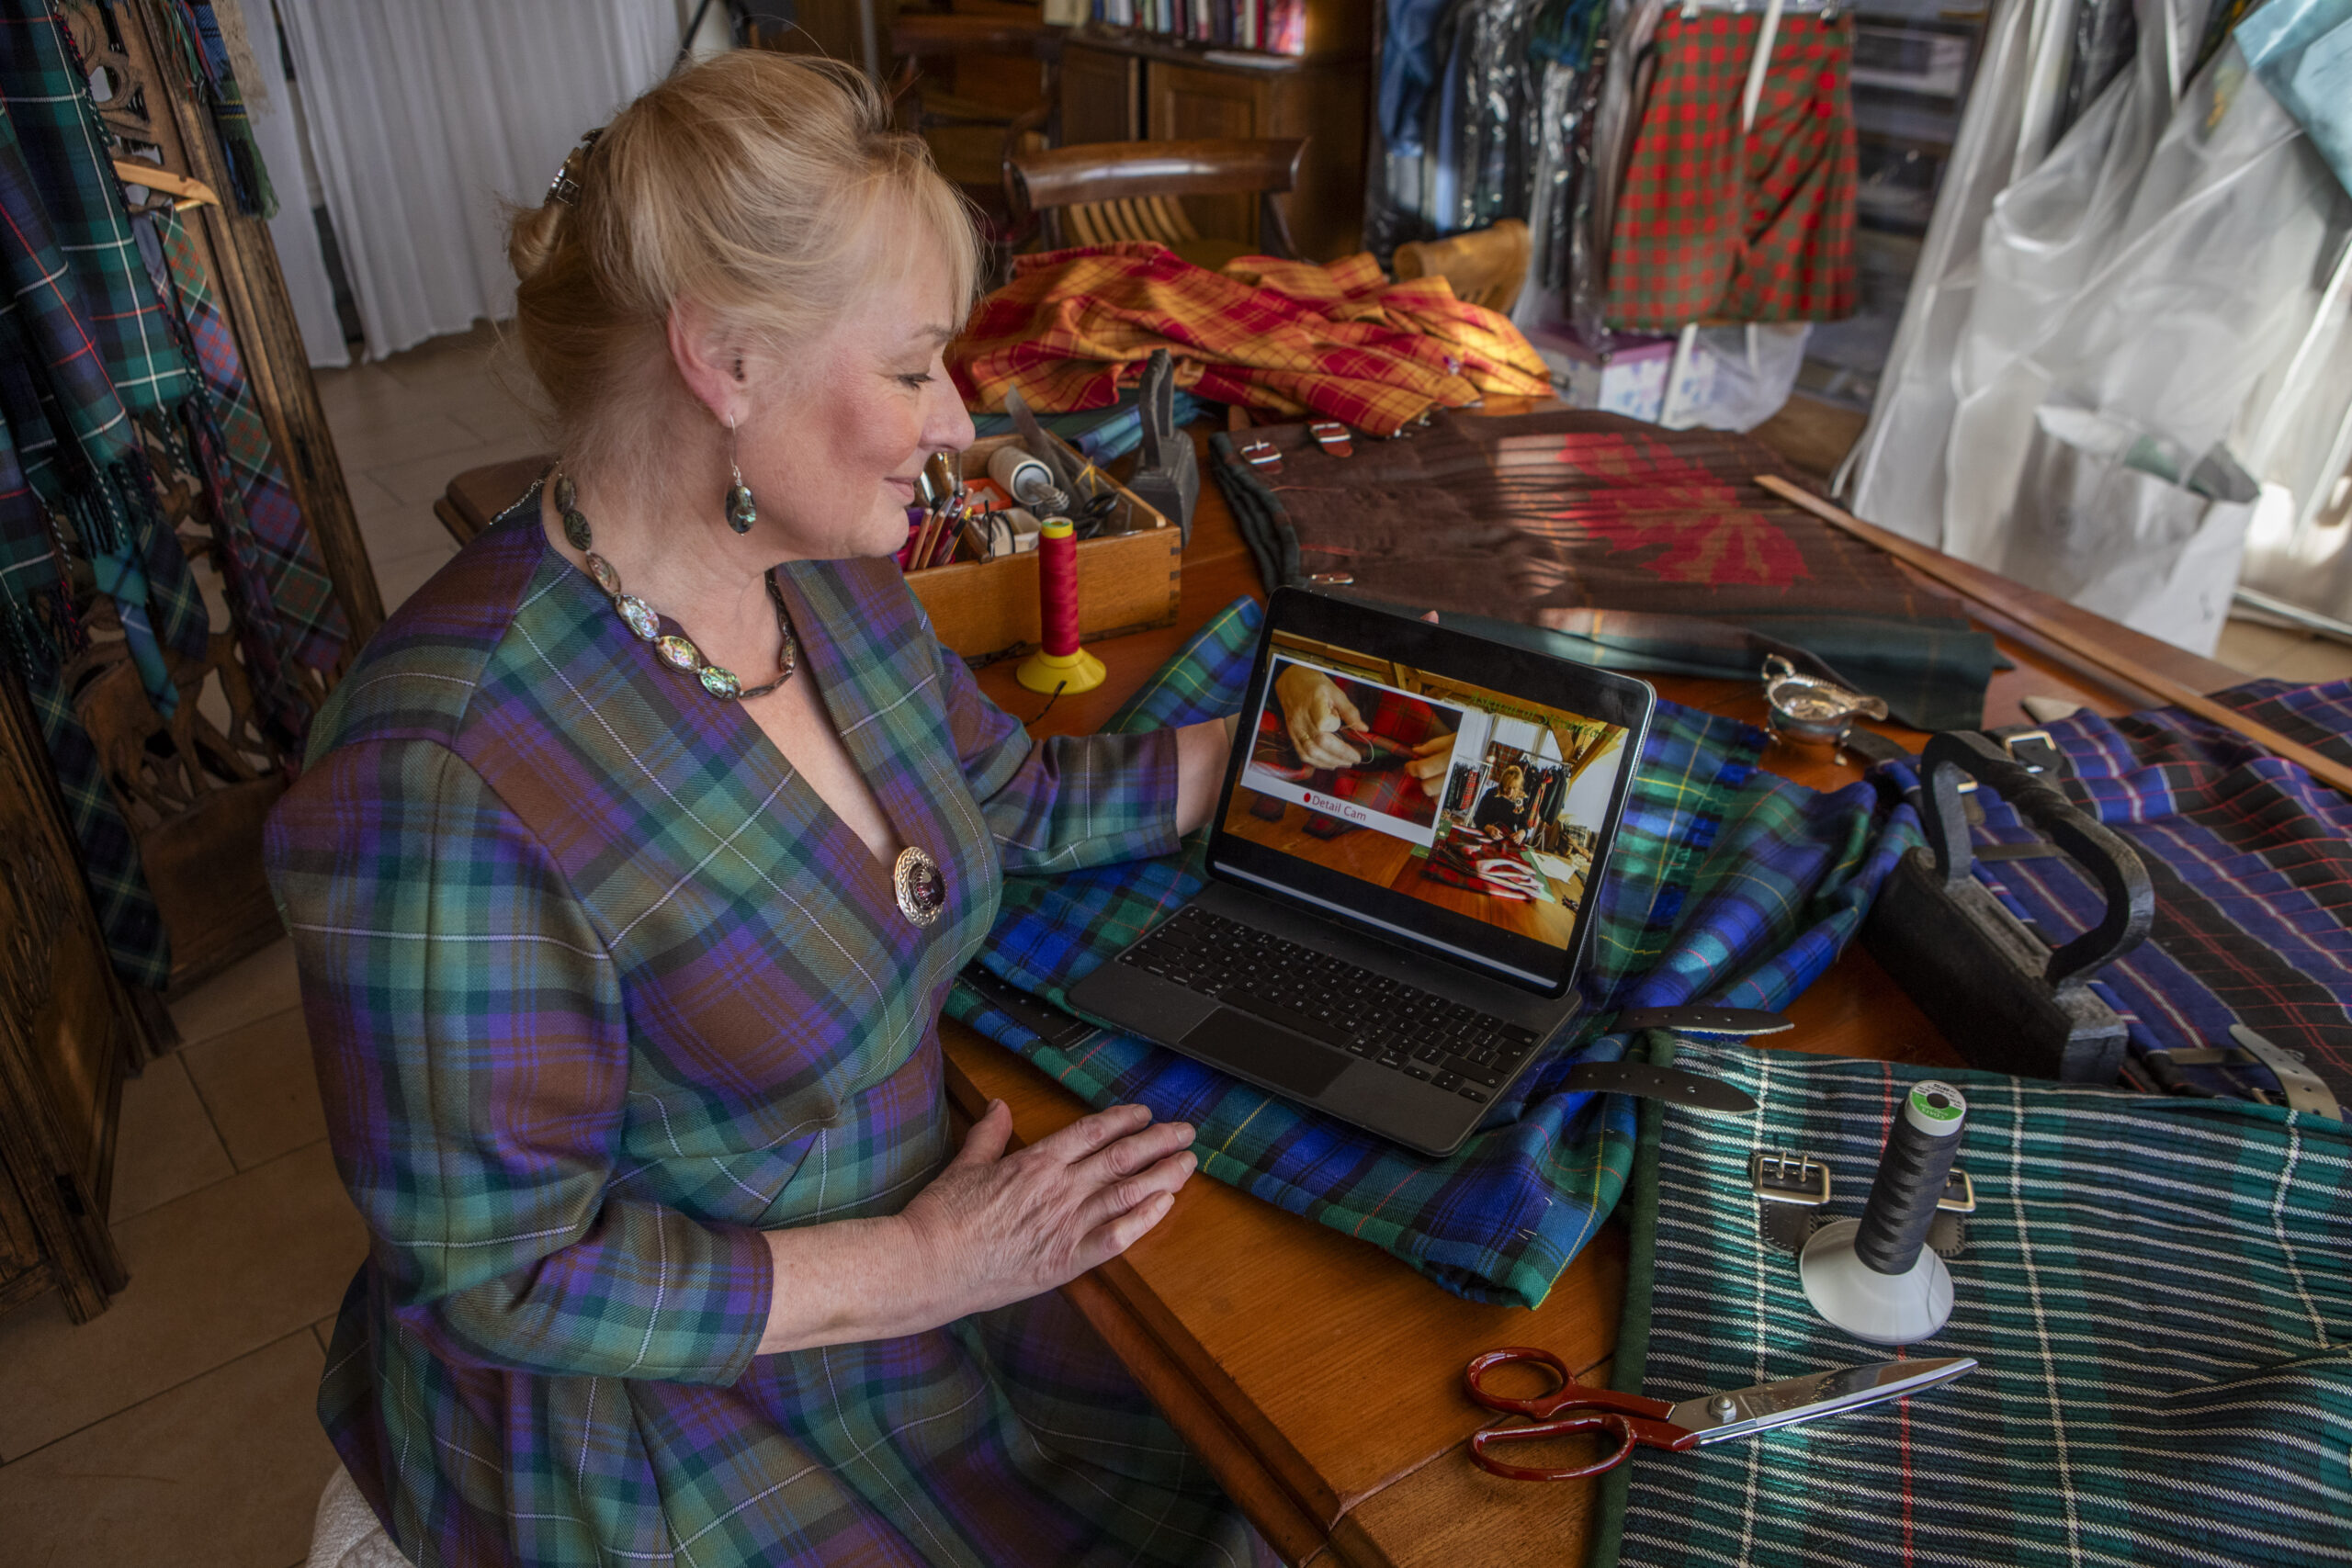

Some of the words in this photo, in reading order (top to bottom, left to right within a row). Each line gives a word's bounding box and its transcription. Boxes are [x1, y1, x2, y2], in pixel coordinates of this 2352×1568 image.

[1521, 705, 1542, 724] of
[1312, 795, 1341, 814] Detail
[1343, 806, 1366, 821] Cam
[1921, 1108, 1945, 1120] COATS
